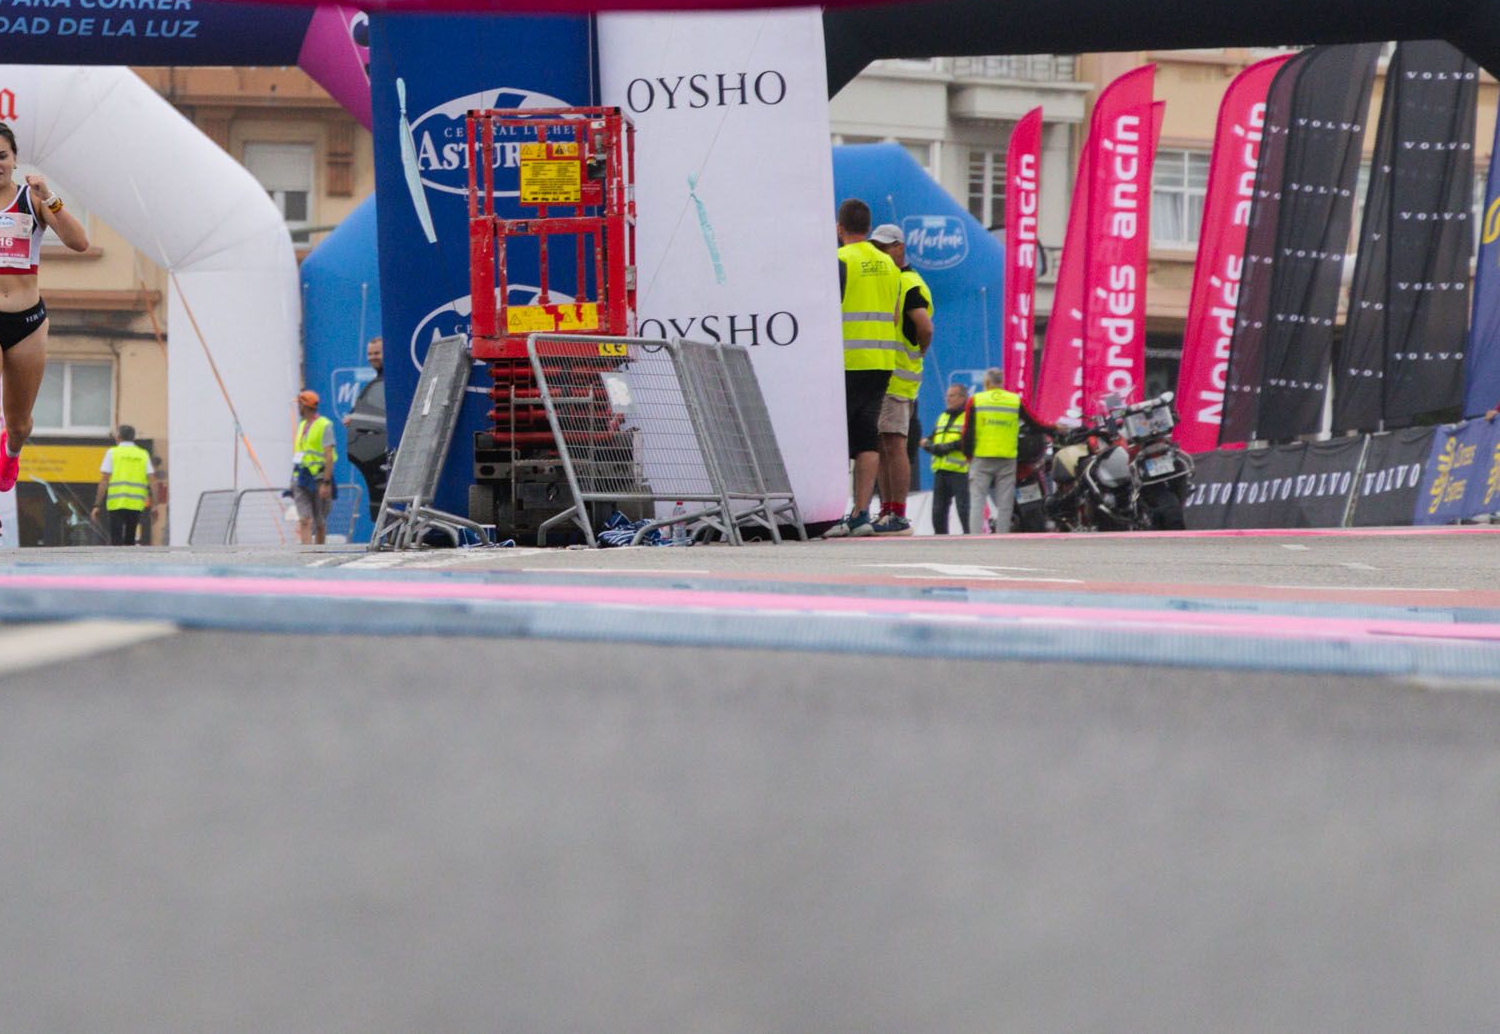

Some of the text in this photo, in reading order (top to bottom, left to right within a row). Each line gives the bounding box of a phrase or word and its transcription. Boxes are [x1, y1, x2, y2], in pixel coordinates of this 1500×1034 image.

[57, 18, 94, 37] DE
[101, 19, 137, 38] LA
[145, 19, 199, 39] LUZ
[1406, 71, 1475, 81] VOLVO
[627, 70, 787, 113] OYSHO
[1298, 118, 1361, 133] VOLVO
[1404, 141, 1471, 151] VOLVO
[1016, 153, 1035, 269] ancín
[1096, 115, 1140, 406] ordés ancín
[1398, 282, 1465, 291] VOLVO
[1276, 313, 1332, 327] VOLVO
[639, 311, 799, 354] OYSHO
[1395, 352, 1464, 361] VOLVO
[1269, 378, 1324, 392] VOLVO
[1186, 463, 1420, 507] LVO VOLVO VOLVO VOLVO
